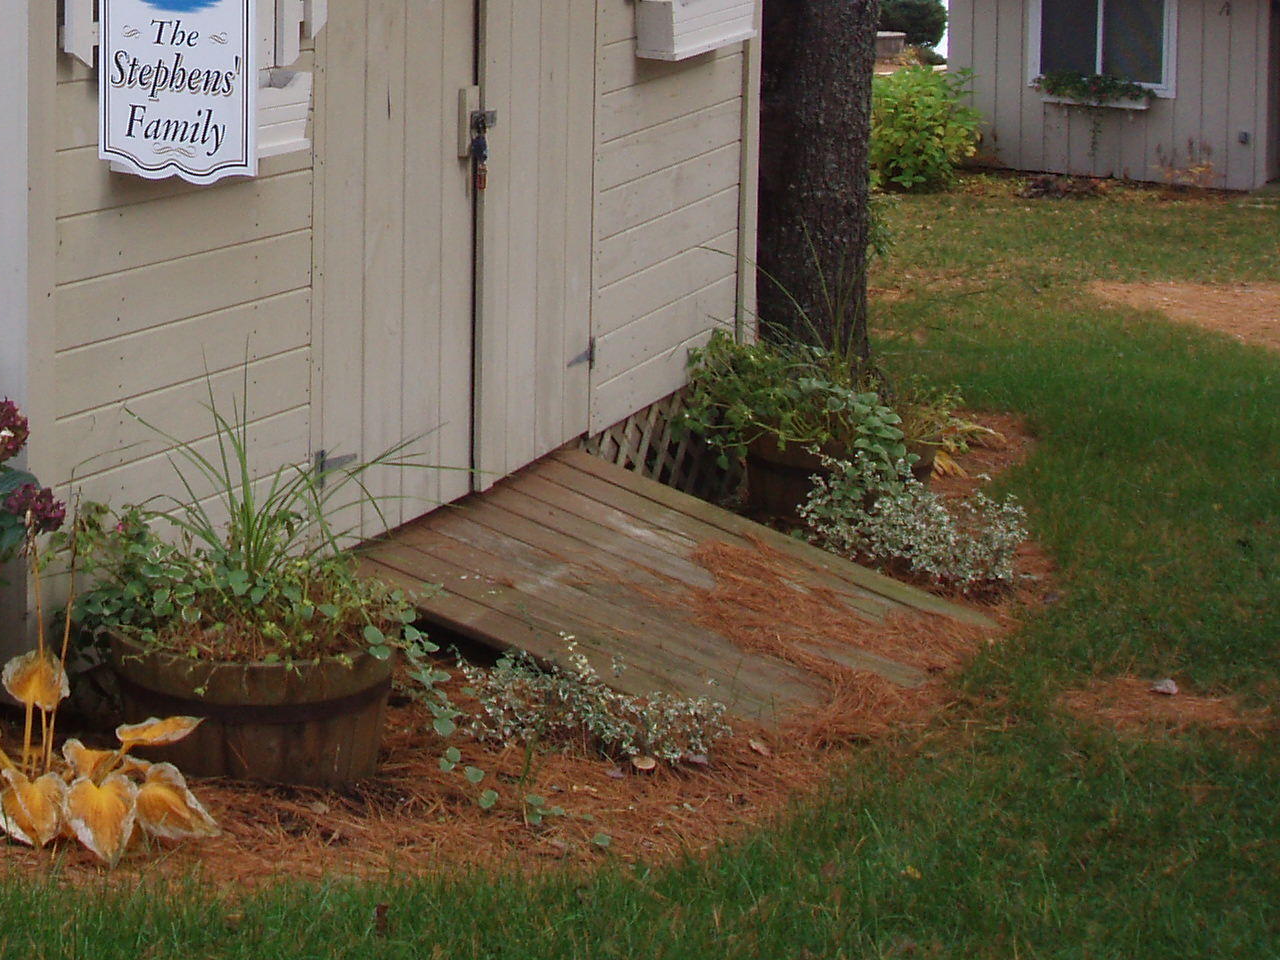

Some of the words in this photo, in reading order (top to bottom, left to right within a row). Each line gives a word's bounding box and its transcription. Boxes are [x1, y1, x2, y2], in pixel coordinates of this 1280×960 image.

[151, 19, 199, 47] The
[110, 49, 242, 103] Stephens'
[125, 103, 226, 157] Family
